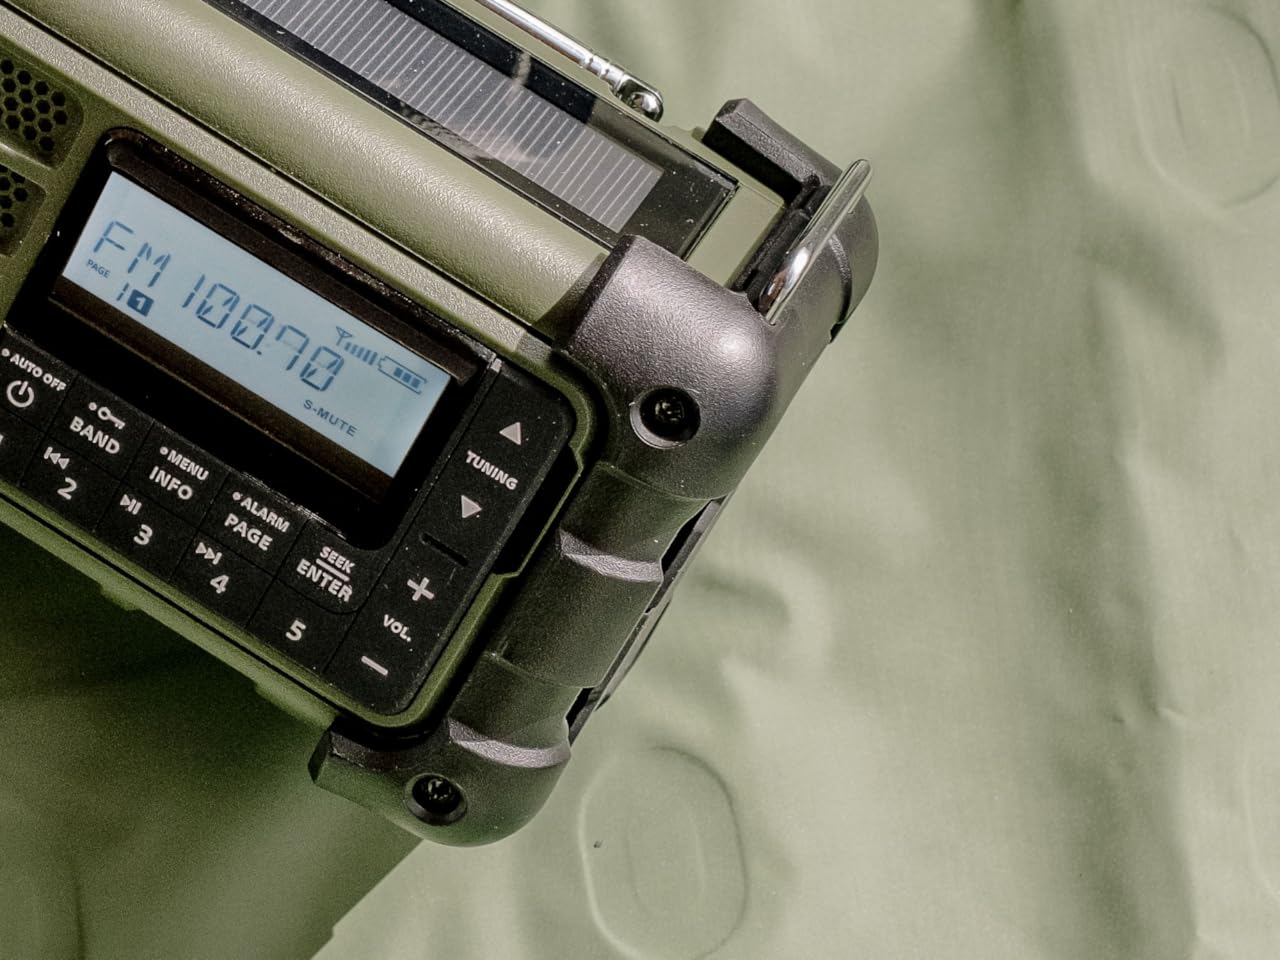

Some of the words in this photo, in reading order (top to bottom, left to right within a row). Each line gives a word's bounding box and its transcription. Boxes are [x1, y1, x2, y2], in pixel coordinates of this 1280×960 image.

[86, 259, 111, 279] PAGE
[92, 220, 172, 288] FM
[182, 274, 346, 392] 100.70
[9, 353, 43, 378] AUTO
[42, 373, 67, 392] OFF
[70, 416, 120, 455] BAND
[303, 399, 357, 437] S-MUTE
[167, 449, 210, 481] MENU
[465, 450, 519, 491] TUNING
[57, 477, 78, 500] 2
[149, 466, 194, 501] INFO
[224, 513, 273, 551] PAGE
[240, 496, 291, 533] ALARM
[133, 524, 153, 546] 3
[319, 545, 356, 574] SEEK
[210, 574, 230, 594] 4
[296, 558, 353, 603] ENTER
[285, 619, 307, 642] 5
[383, 613, 412, 642] VOL.
